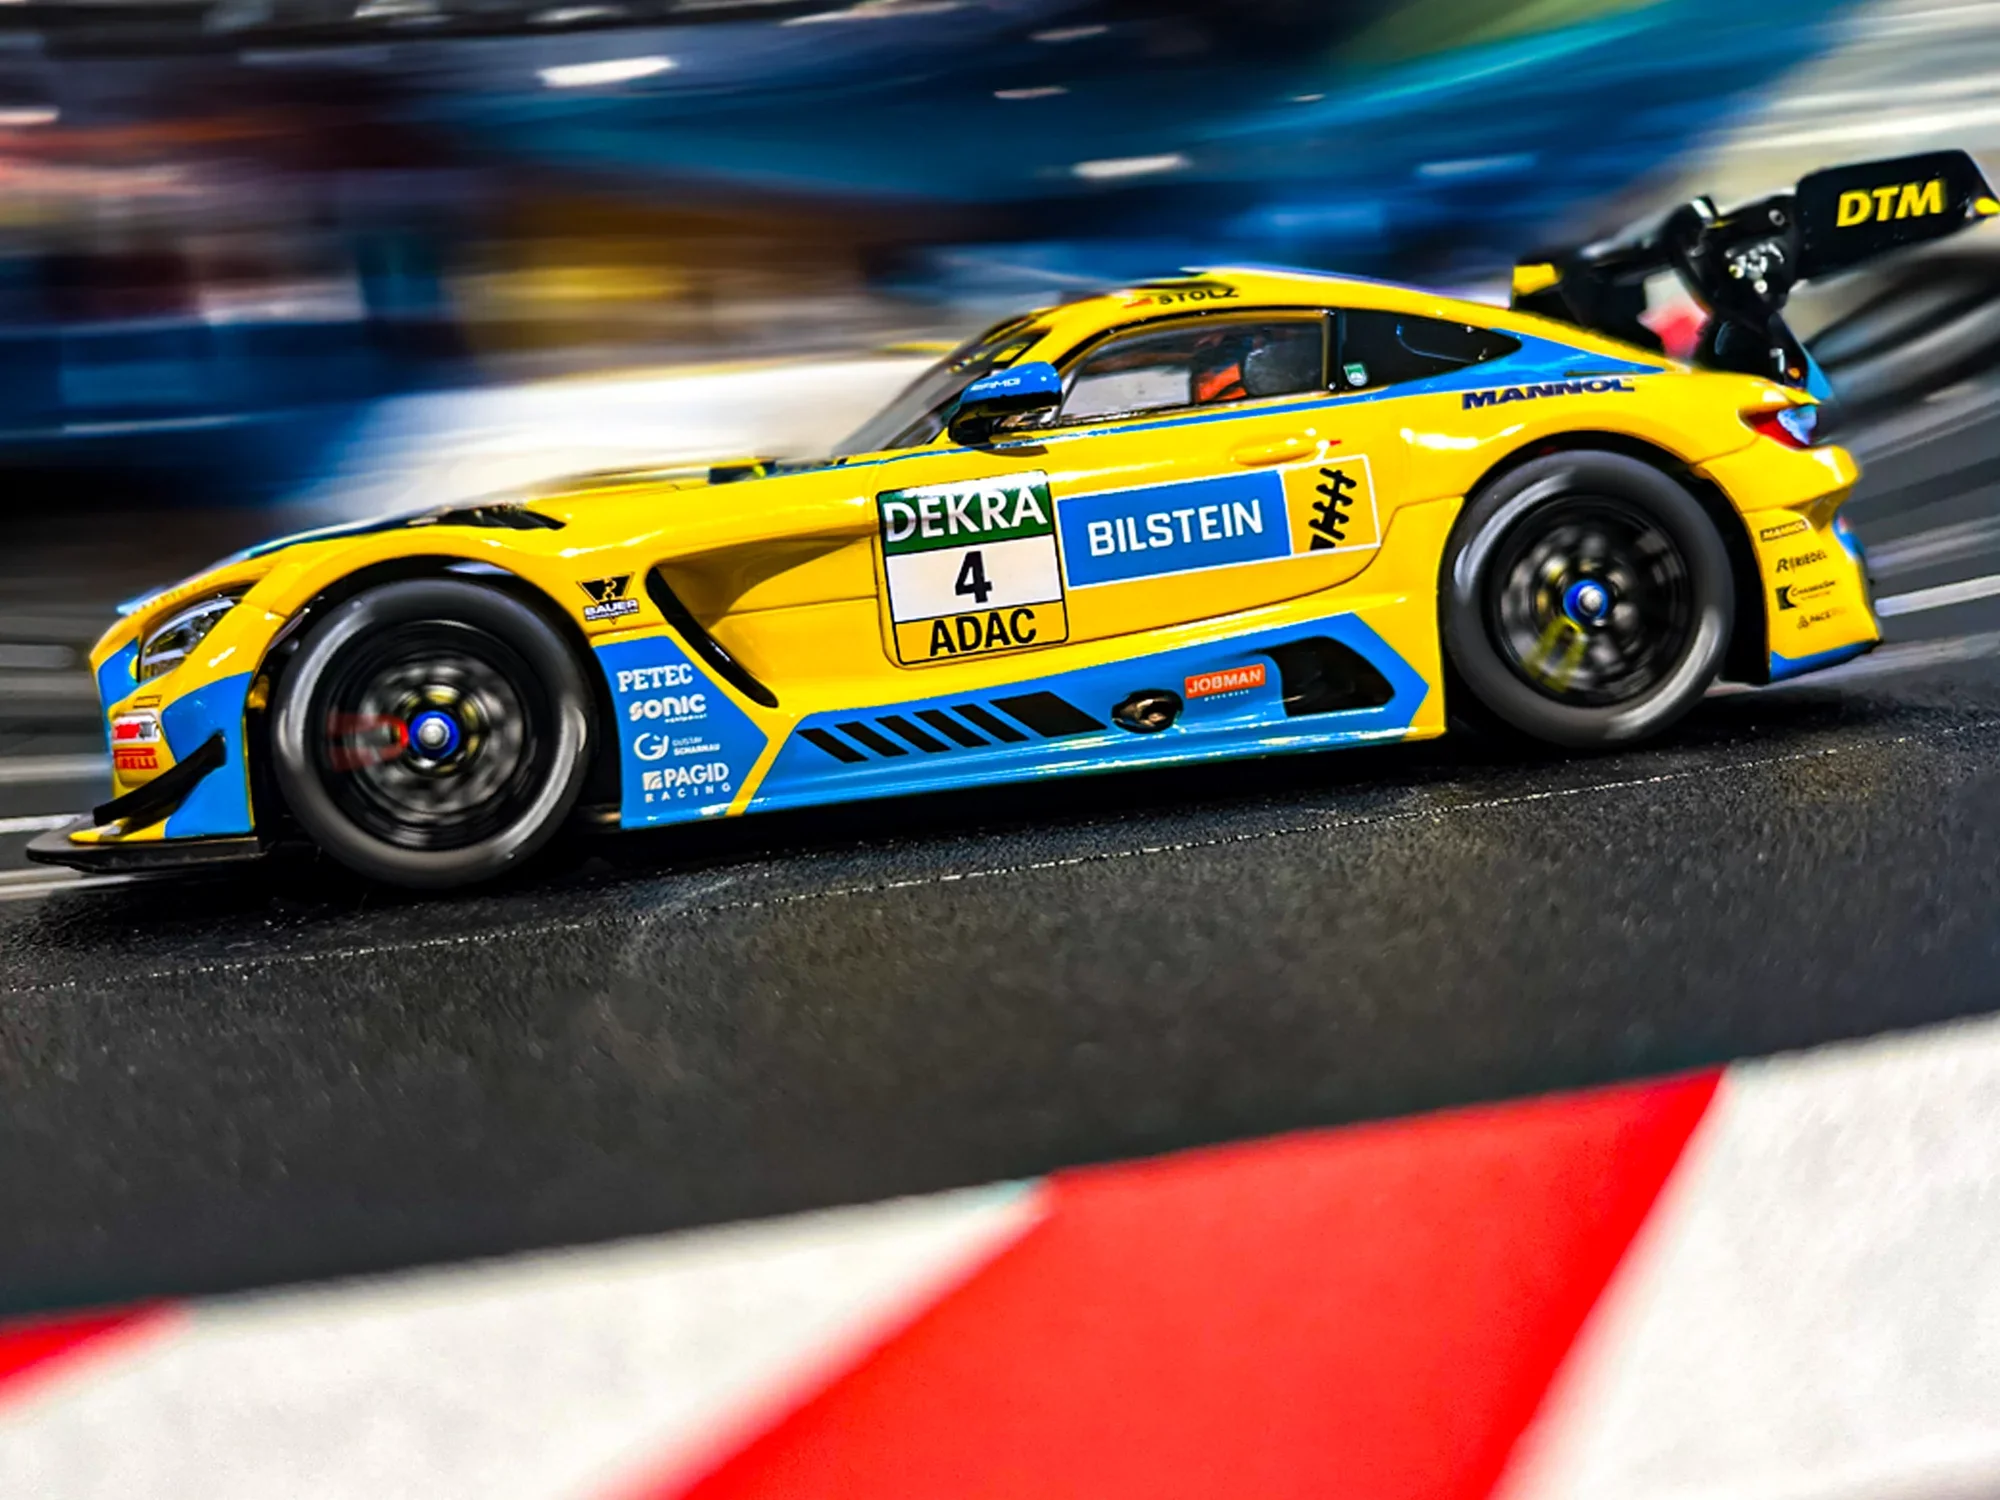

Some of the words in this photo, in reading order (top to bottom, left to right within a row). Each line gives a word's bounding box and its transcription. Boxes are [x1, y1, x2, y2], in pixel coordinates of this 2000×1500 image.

[1836, 179, 1944, 228] DTM
[1158, 287, 1239, 305] STOLZ
[1462, 378, 1635, 410] MANNOL
[883, 484, 1048, 543] DEKRA
[1087, 499, 1263, 557] BILSTEIN
[955, 550, 992, 603] 4
[929, 608, 1037, 656] ADAC
[616, 663, 693, 692] PETEC
[1188, 669, 1262, 693] JOBMAN
[664, 762, 729, 788] PAGID
[644, 782, 731, 803] RACING
